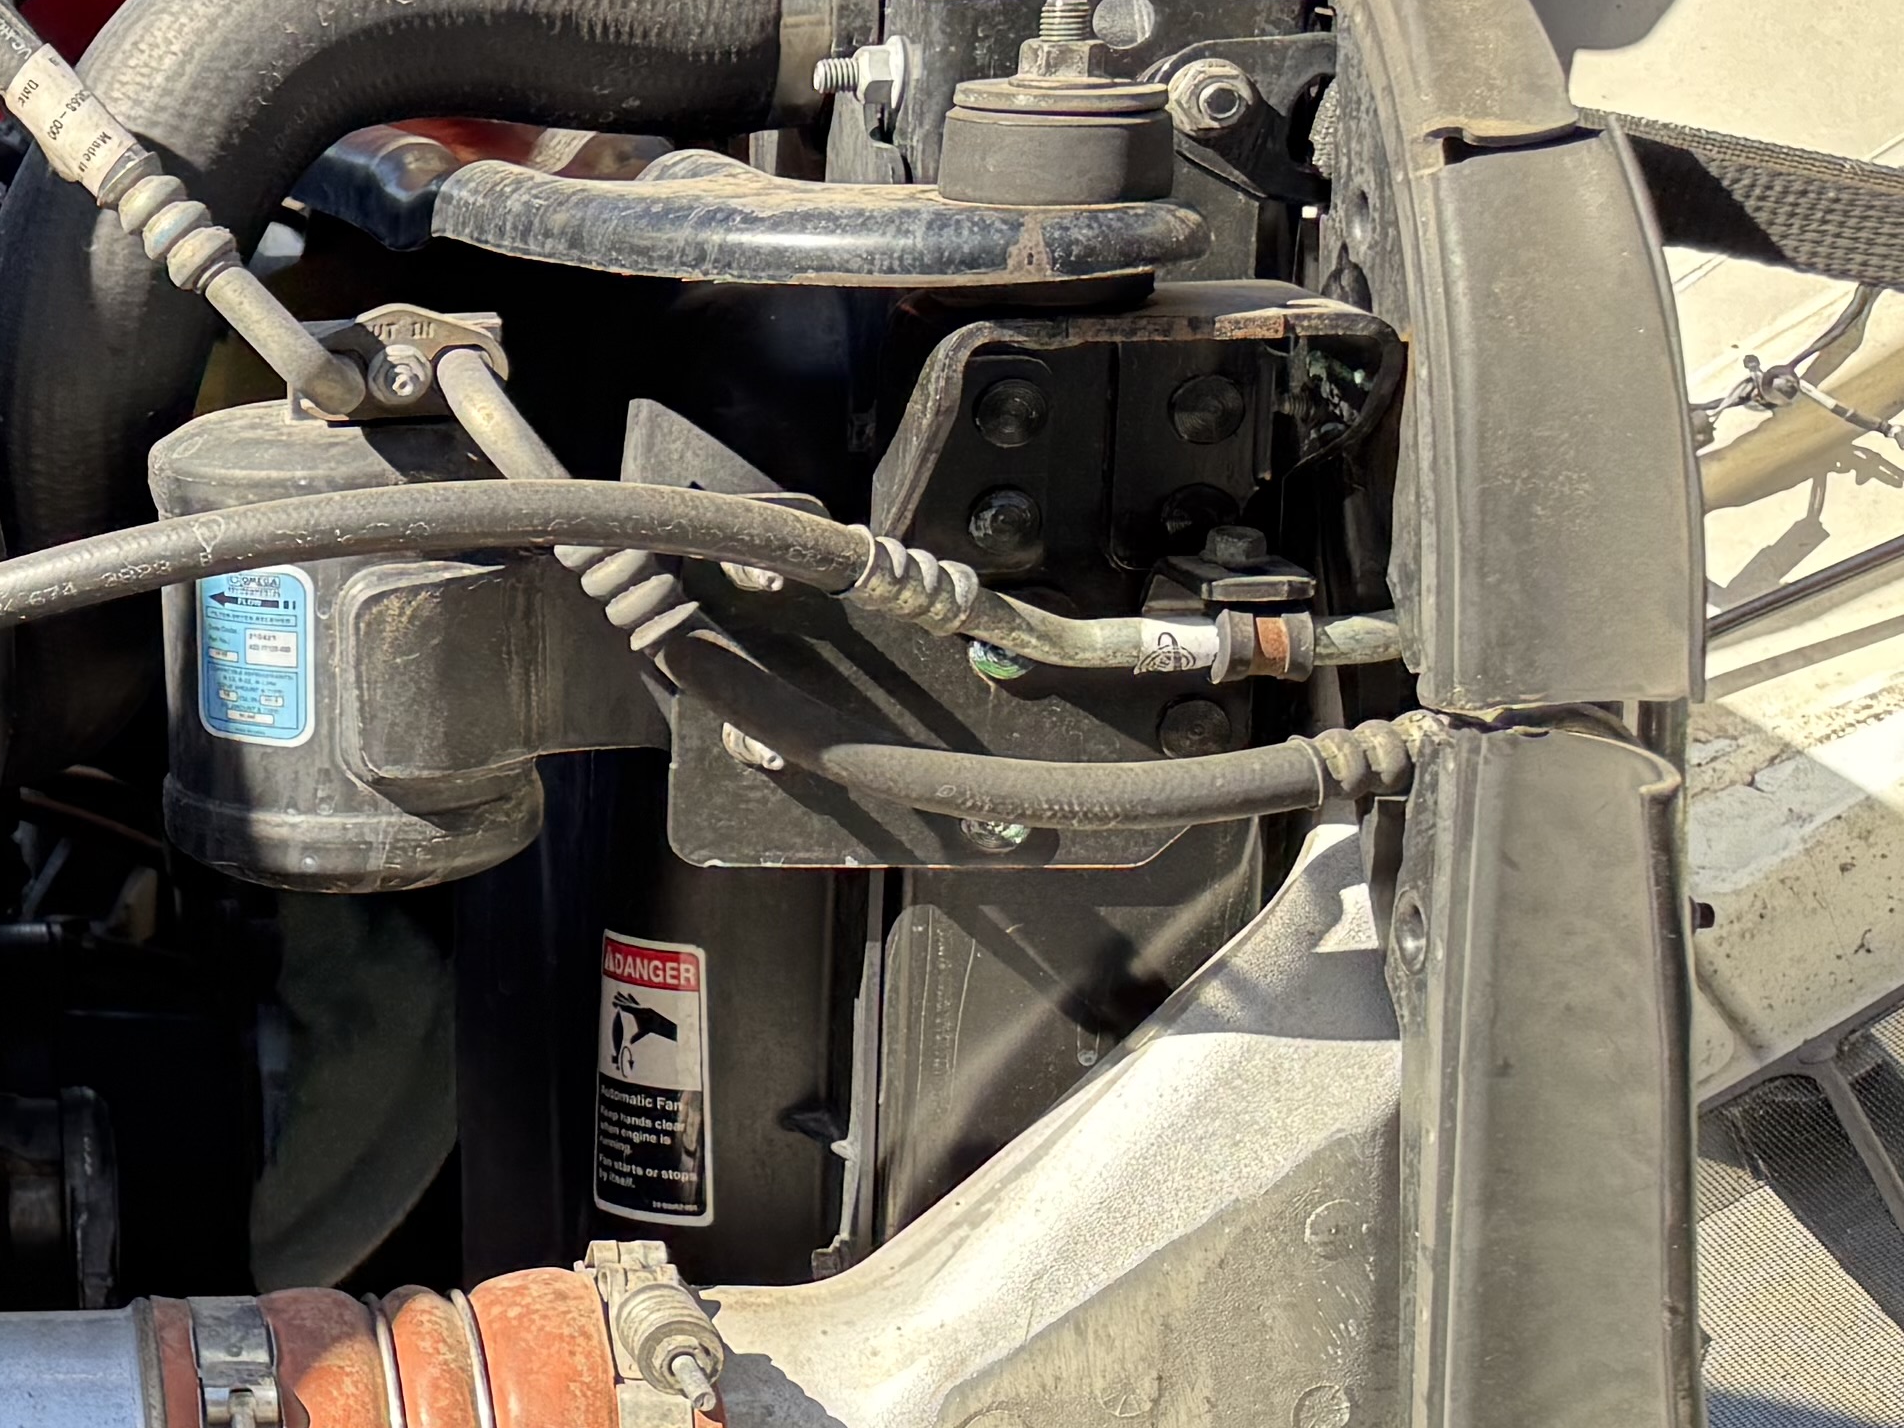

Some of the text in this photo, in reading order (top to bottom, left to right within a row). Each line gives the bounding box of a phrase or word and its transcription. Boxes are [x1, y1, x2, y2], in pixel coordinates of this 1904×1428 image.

[615, 952, 696, 986] DANGER
[601, 1084, 682, 1112] Automatic Fan
[599, 1122, 672, 1145] when engine is
[600, 1106, 685, 1133] Keep hands clear
[599, 1153, 697, 1185] Fan starts or stops
